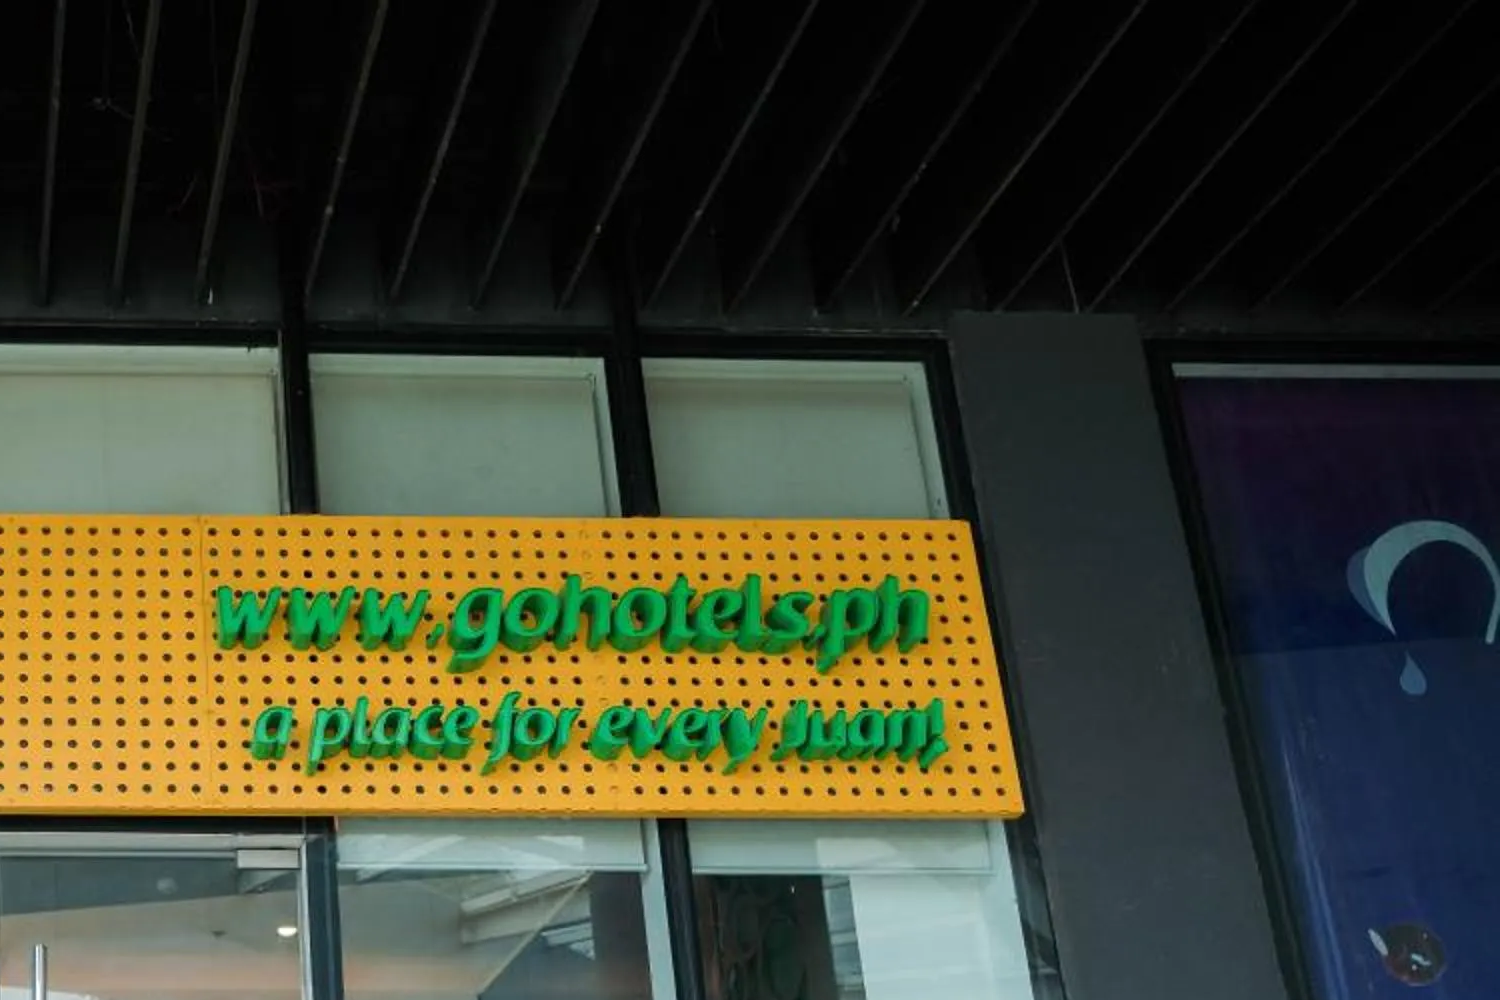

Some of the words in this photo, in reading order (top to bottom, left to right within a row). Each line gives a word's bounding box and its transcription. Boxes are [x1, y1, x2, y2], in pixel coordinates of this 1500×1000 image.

[214, 574, 930, 674] www.gohotels.ph
[250, 705, 294, 760] a
[305, 696, 480, 777] place
[480, 691, 583, 776] for
[587, 705, 769, 776] every
